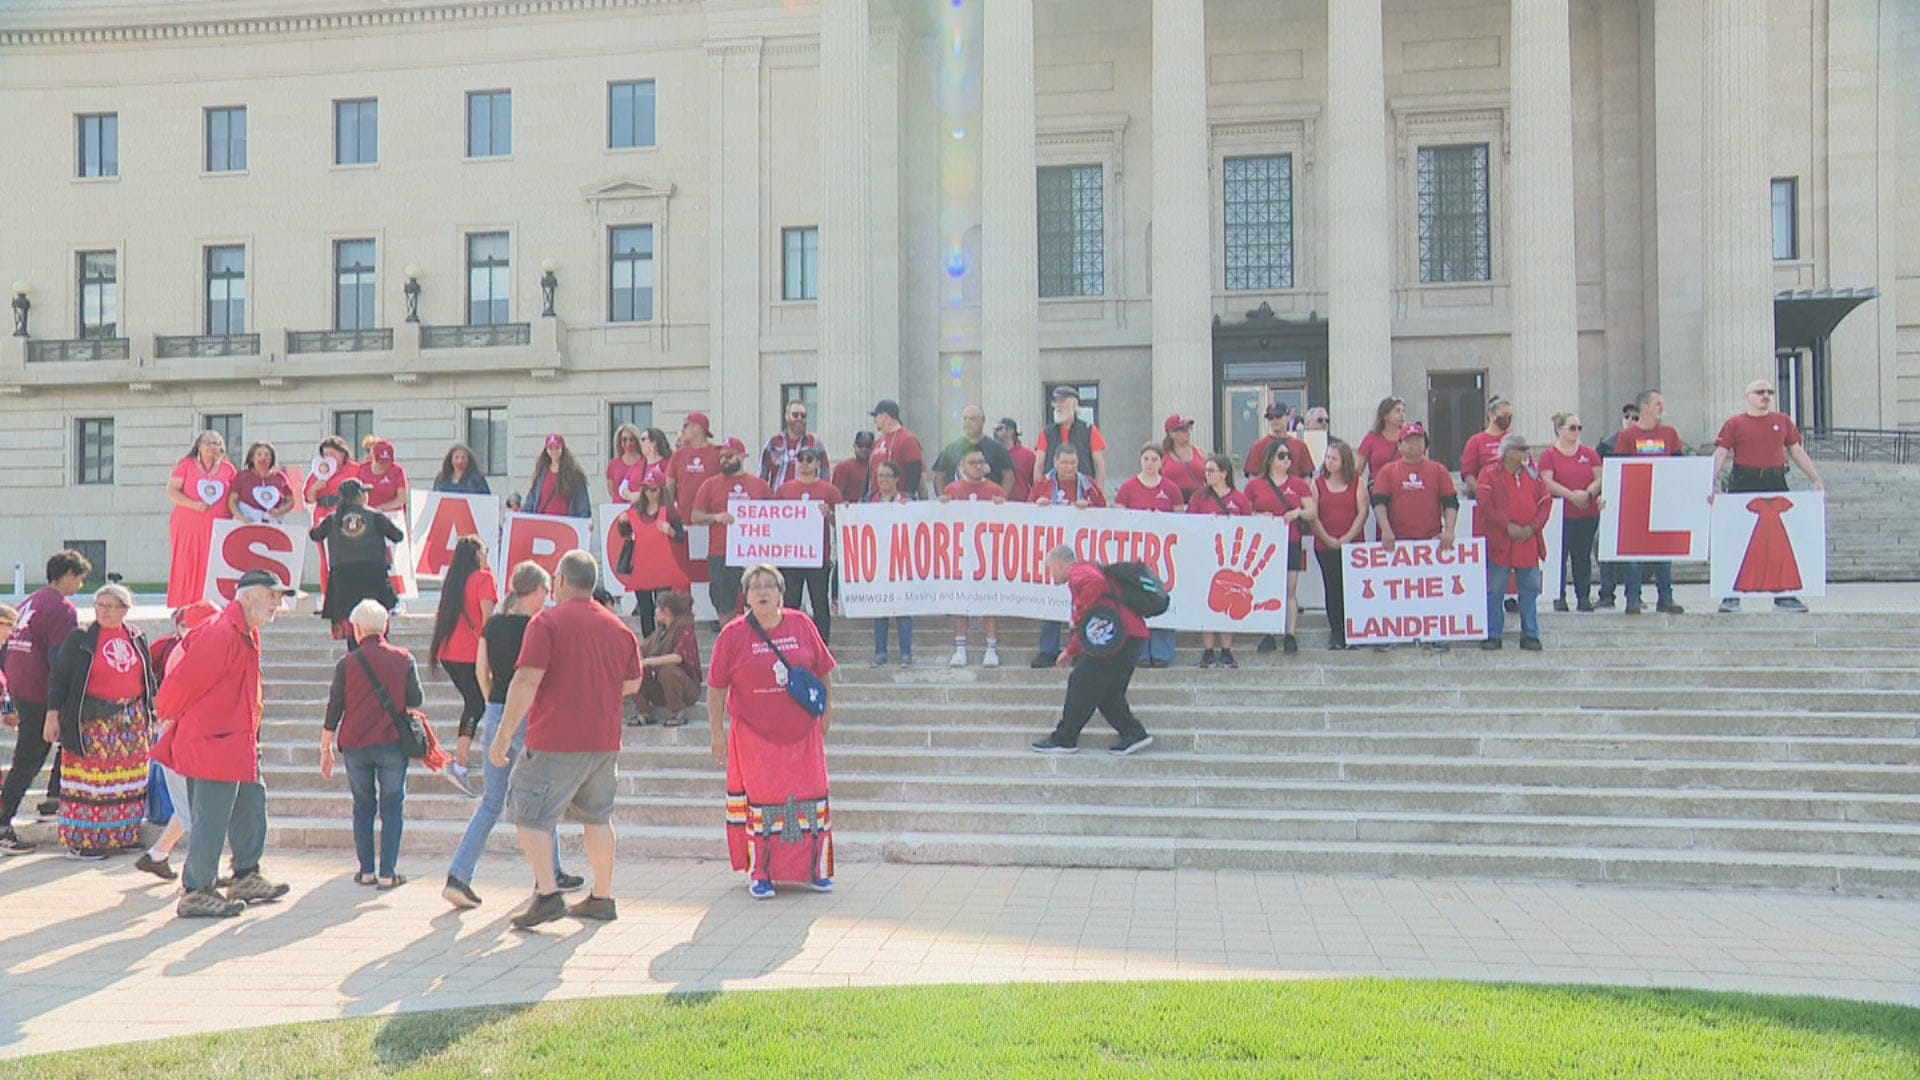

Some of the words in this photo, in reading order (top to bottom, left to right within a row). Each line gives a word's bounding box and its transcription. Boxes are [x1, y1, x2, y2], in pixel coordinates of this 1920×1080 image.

[736, 505, 807, 519] SEARCH
[1616, 463, 1691, 555] L
[415, 496, 490, 575] A
[739, 523, 771, 537] THE
[216, 525, 293, 602] S
[737, 543, 817, 559] LANDFILL
[842, 523, 878, 583] NO
[889, 521, 965, 582] MORE
[1350, 543, 1479, 568] SEARCH
[1383, 576, 1444, 600] THE
[1346, 614, 1483, 639] LANDFILL
